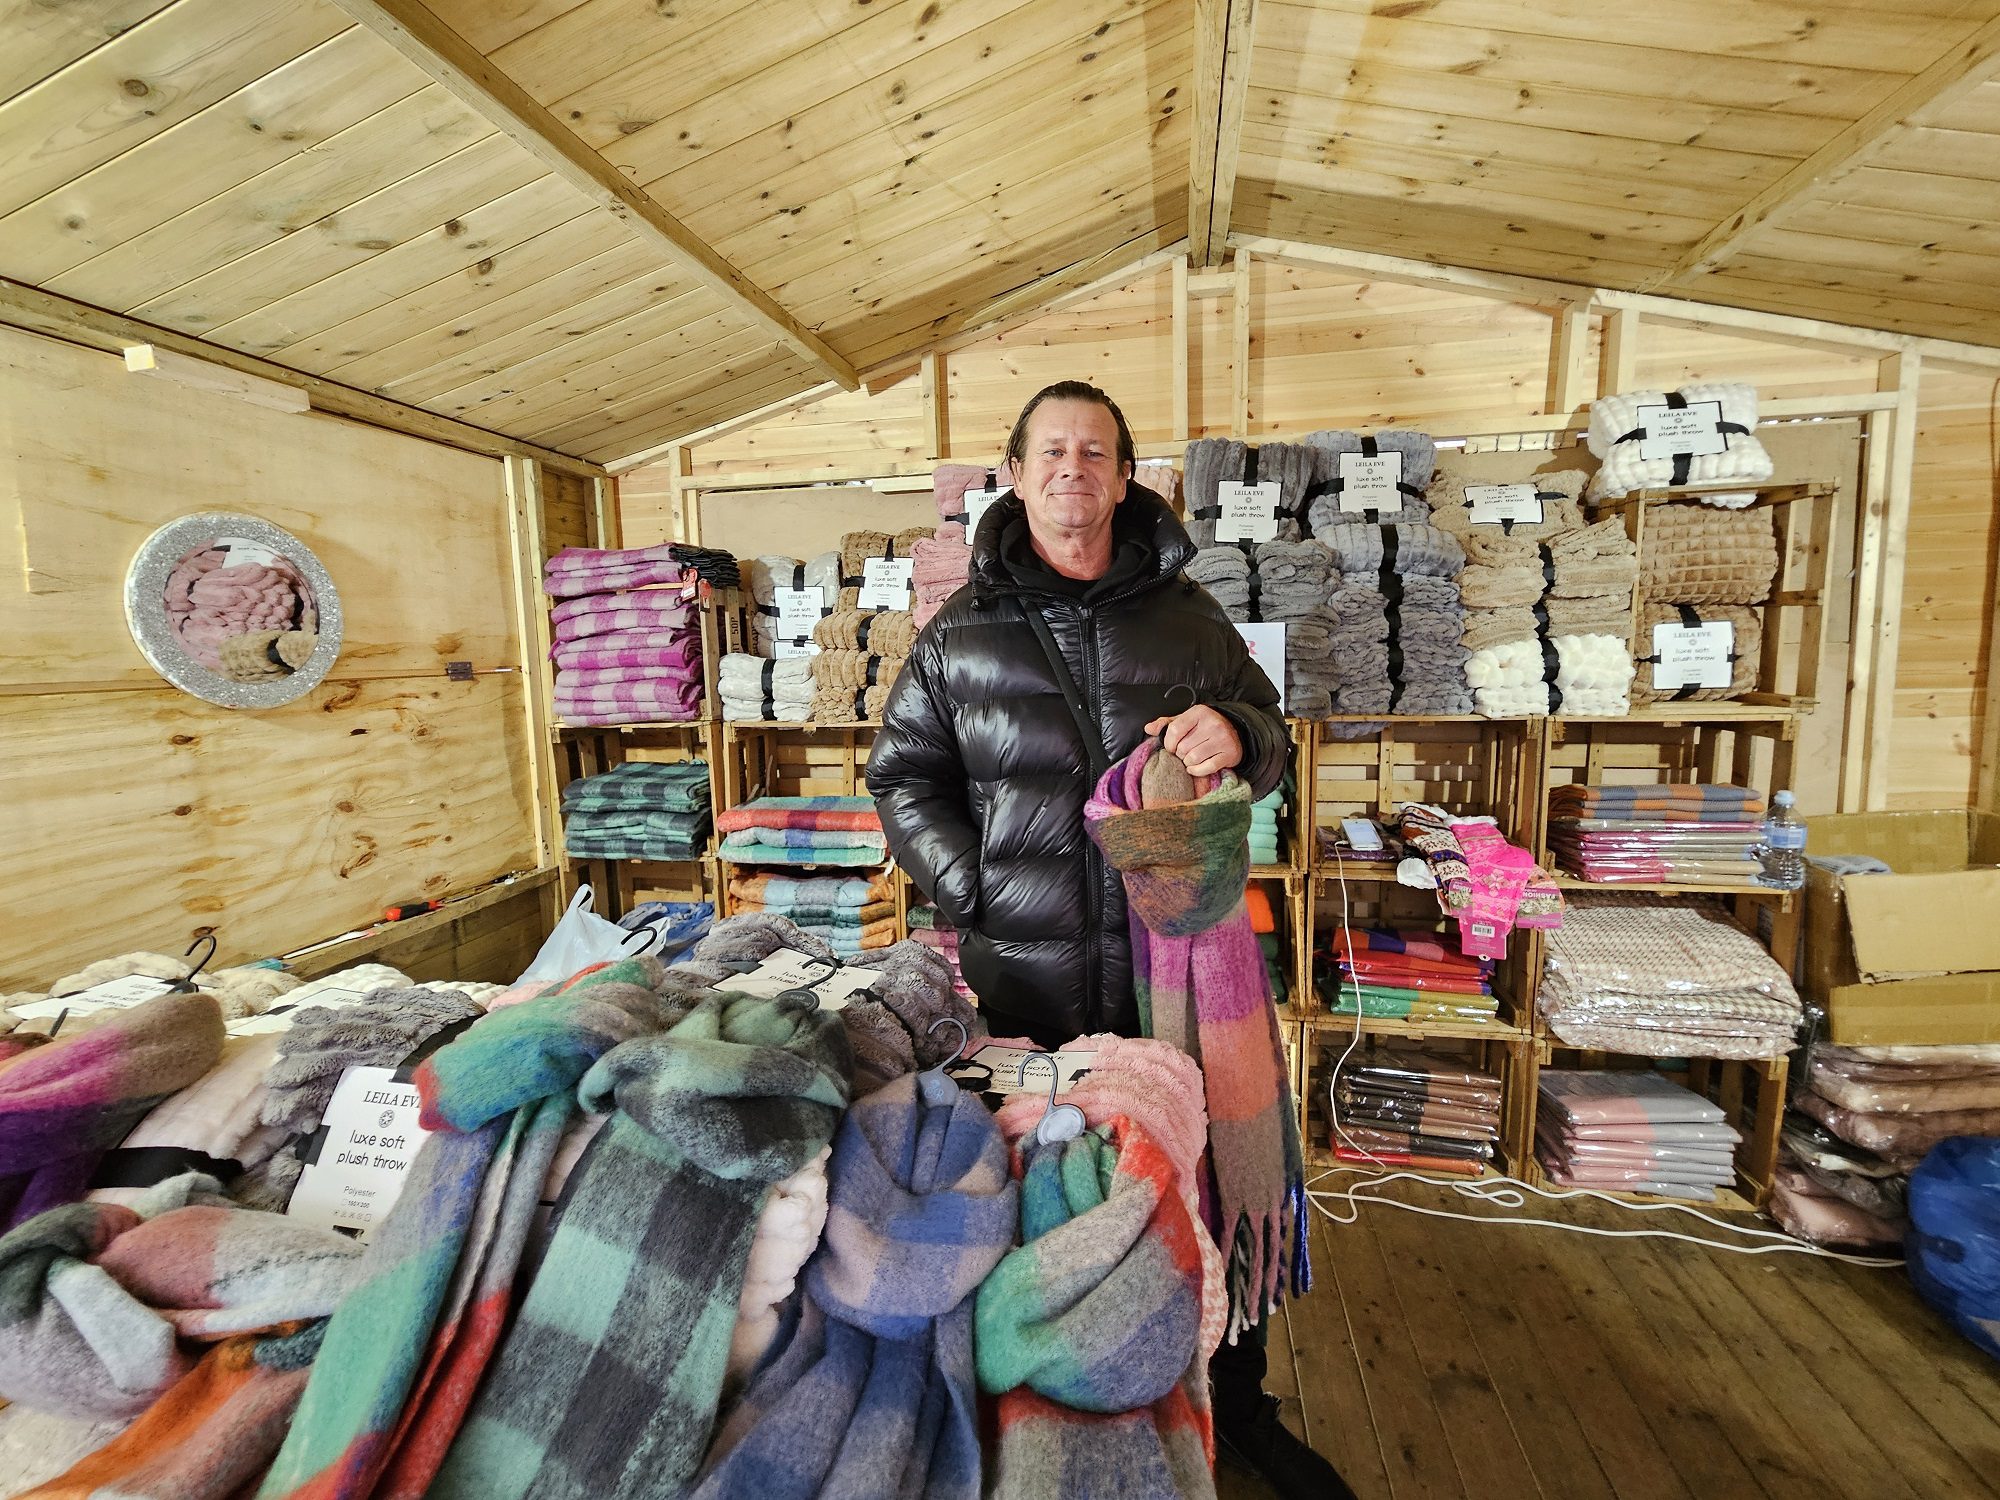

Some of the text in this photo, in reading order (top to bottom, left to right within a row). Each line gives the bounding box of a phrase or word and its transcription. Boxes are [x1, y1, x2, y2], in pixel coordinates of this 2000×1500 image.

[769, 975, 798, 985] plush
[782, 971, 806, 981] luxe
[363, 1091, 398, 1106] LEILA
[350, 1129, 405, 1150] luxe soft
[336, 1150, 408, 1171] plush throw
[344, 1185, 376, 1197] Polyester
